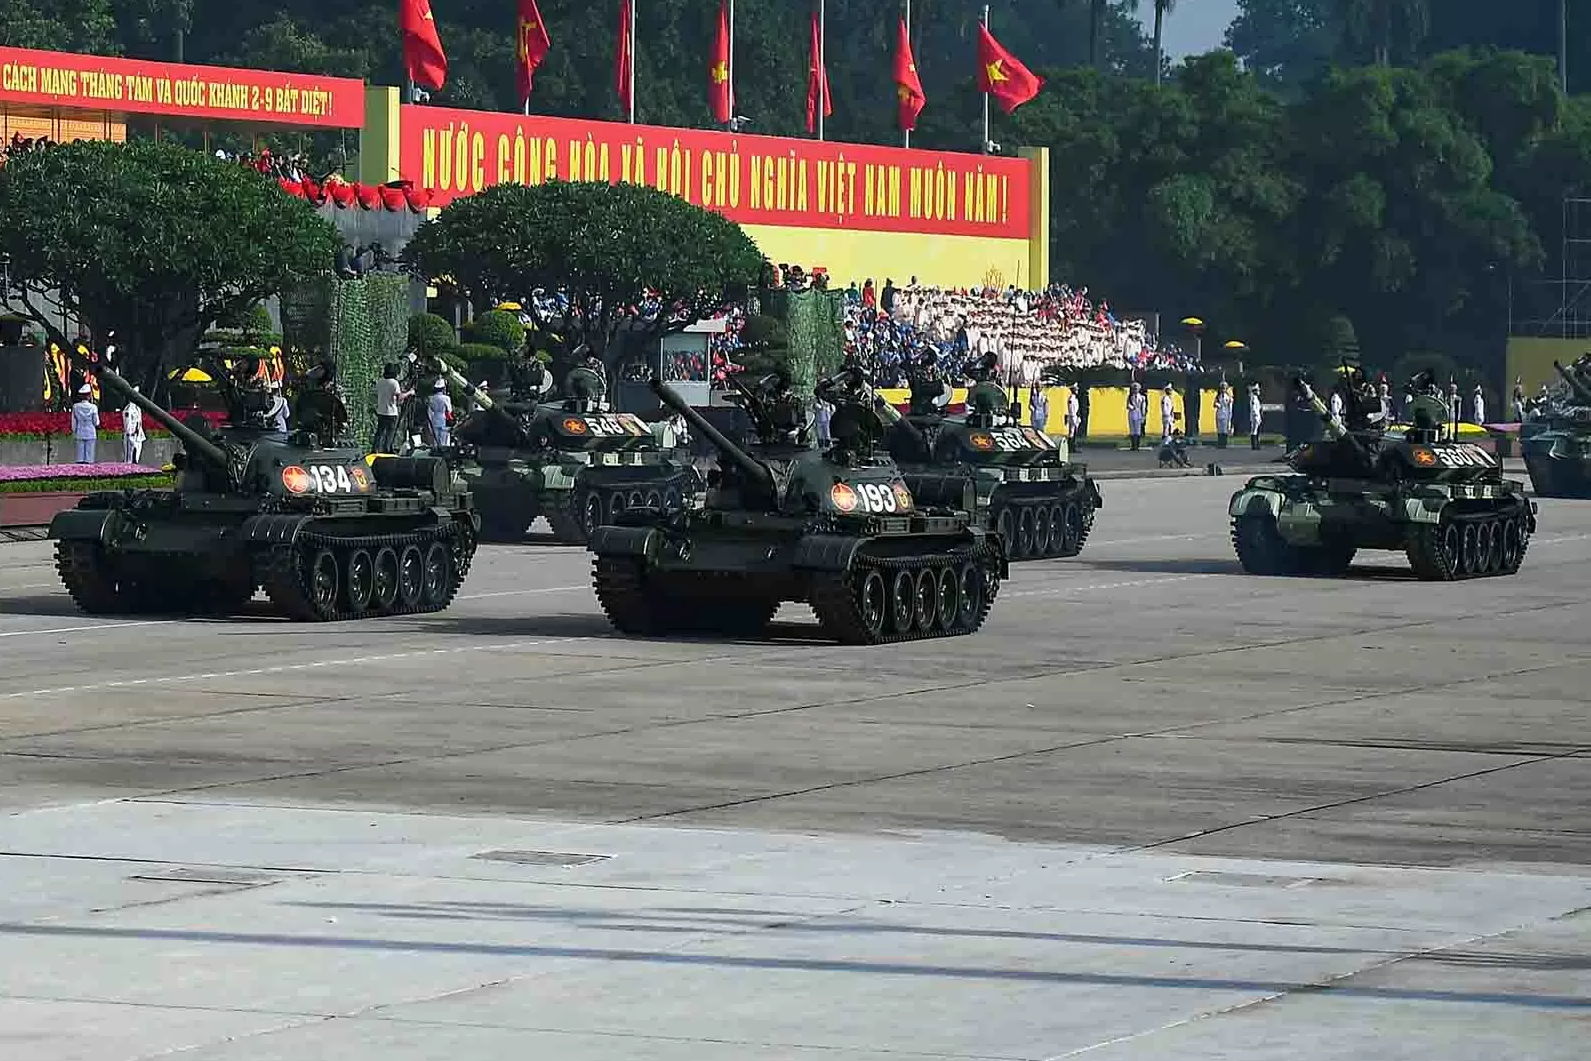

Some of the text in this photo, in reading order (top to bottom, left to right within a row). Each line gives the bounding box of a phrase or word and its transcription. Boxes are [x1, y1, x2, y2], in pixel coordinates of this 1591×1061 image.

[3, 59, 37, 92] CÁCH
[40, 67, 77, 99] MẠNG
[80, 68, 123, 100] THÁNG
[126, 72, 153, 102] TÁM
[156, 72, 172, 104] VÀ
[175, 74, 206, 107] QUỐC
[209, 78, 249, 110] KHÁNH
[251, 86, 273, 112] 2-9
[275, 82, 299, 113] BẤT
[422, 121, 484, 192] NƯỚC
[569, 132, 609, 183] HÒA
[701, 140, 740, 208] CHỦ
[750, 149, 808, 212] NGHĨA
[817, 152, 856, 224] VIỆT
[865, 164, 900, 218] NAM
[910, 160, 956, 221] MUÔN
[310, 465, 351, 493] 134
[857, 483, 897, 513] 193
